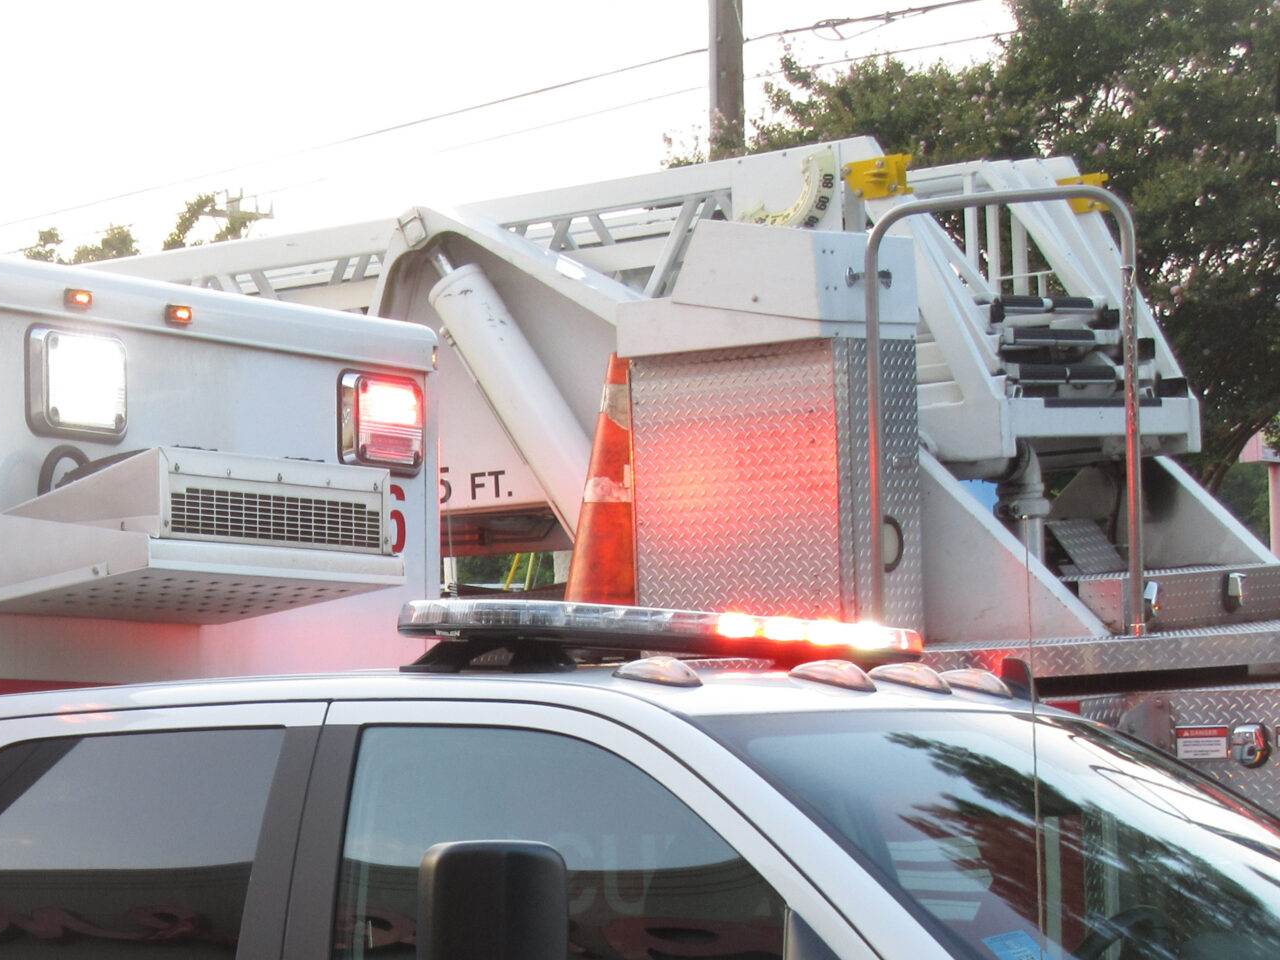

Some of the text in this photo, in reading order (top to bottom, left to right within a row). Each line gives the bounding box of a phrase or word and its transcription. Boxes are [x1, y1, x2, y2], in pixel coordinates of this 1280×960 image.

[822, 173, 834, 189] 80
[815, 195, 830, 211] 60
[470, 469, 513, 500] FT.
